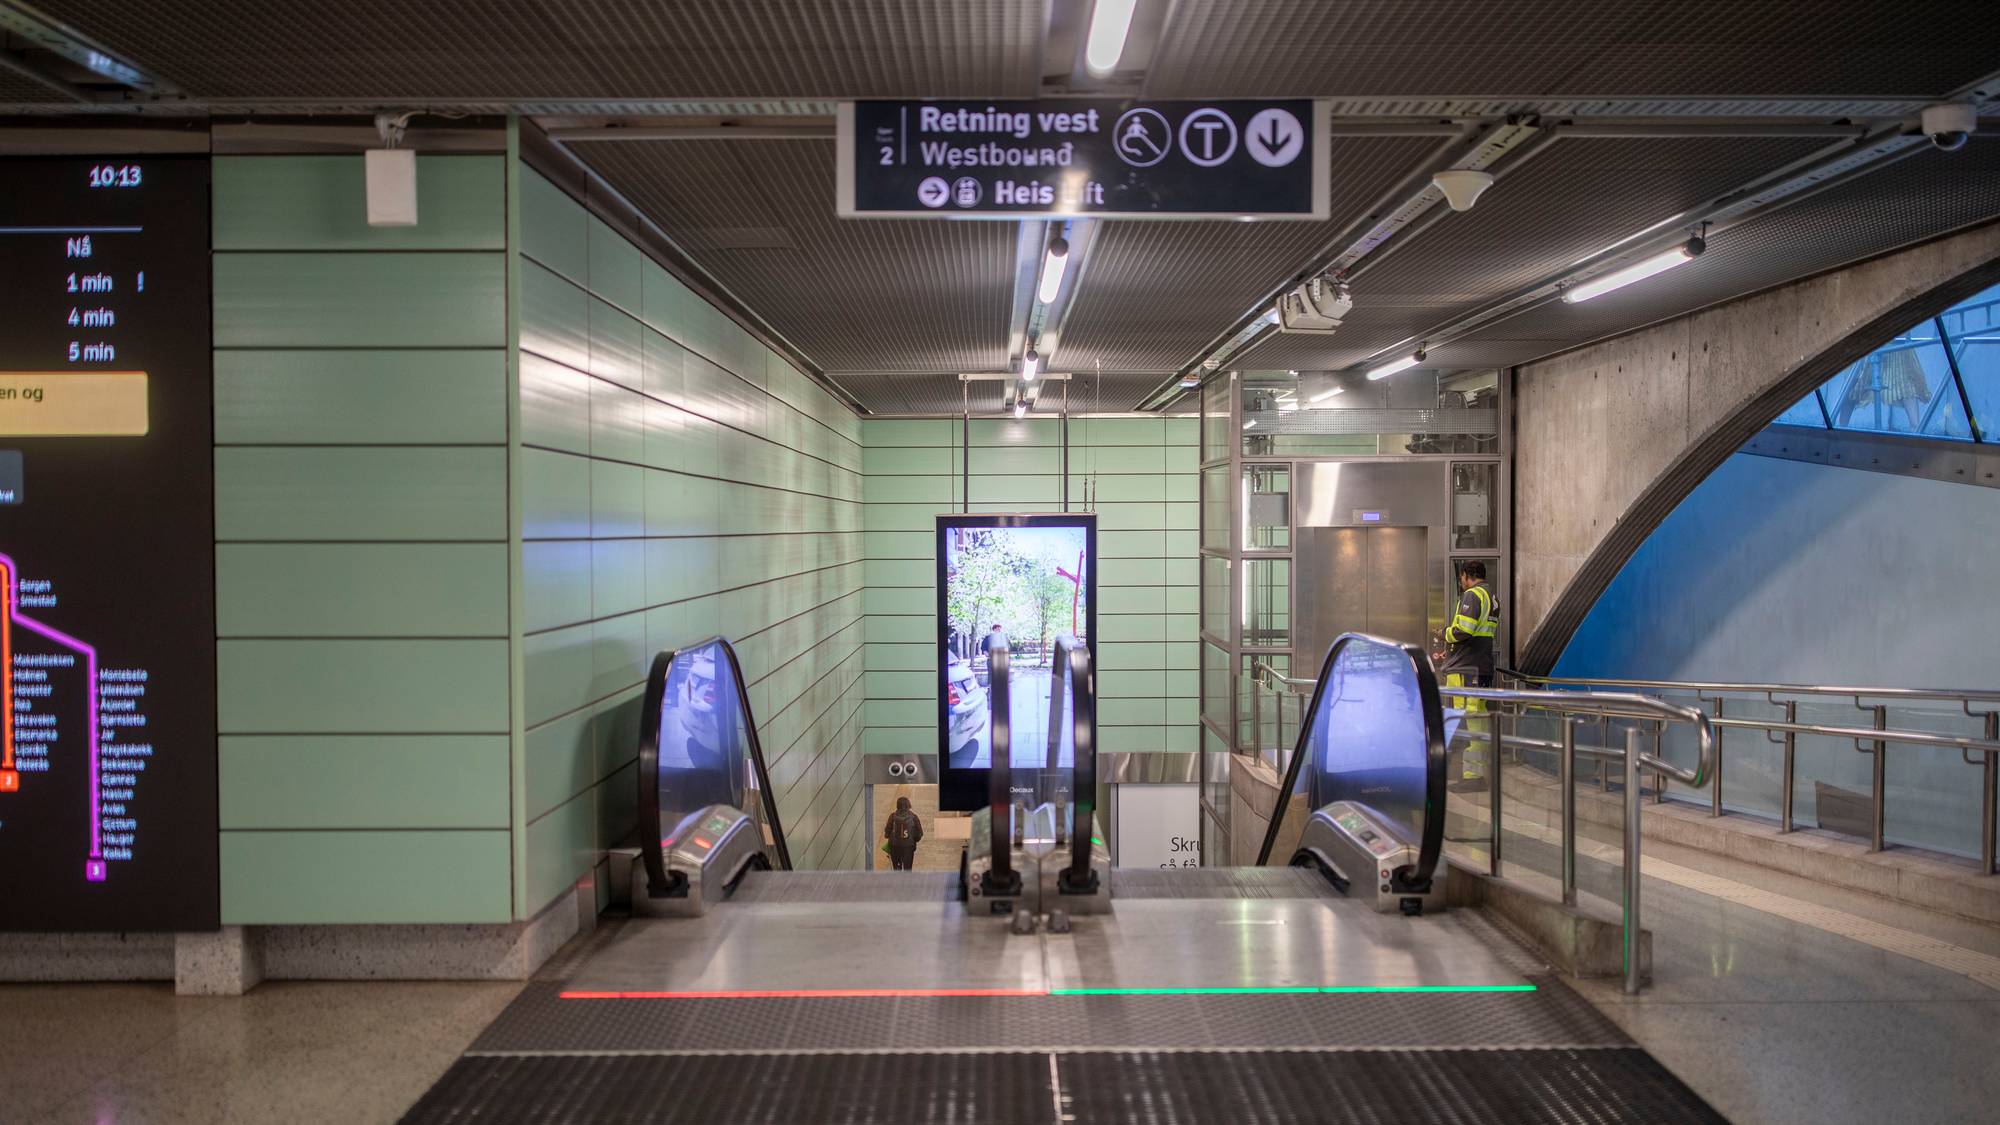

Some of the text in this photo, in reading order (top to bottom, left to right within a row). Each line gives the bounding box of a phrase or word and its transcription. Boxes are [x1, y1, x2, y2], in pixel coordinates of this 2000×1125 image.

[920, 106, 1099, 138] Retning vest
[880, 146, 894, 165] 2
[920, 141, 1074, 166] Westbound
[89, 165, 142, 187] 10:13
[995, 180, 1055, 204] Heis
[67, 235, 92, 257] Nå
[67, 272, 78, 292] 1
[82, 272, 113, 292] min
[68, 307, 115, 327] 4 min
[69, 341, 115, 361] 5 min
[22, 388, 43, 403] og
